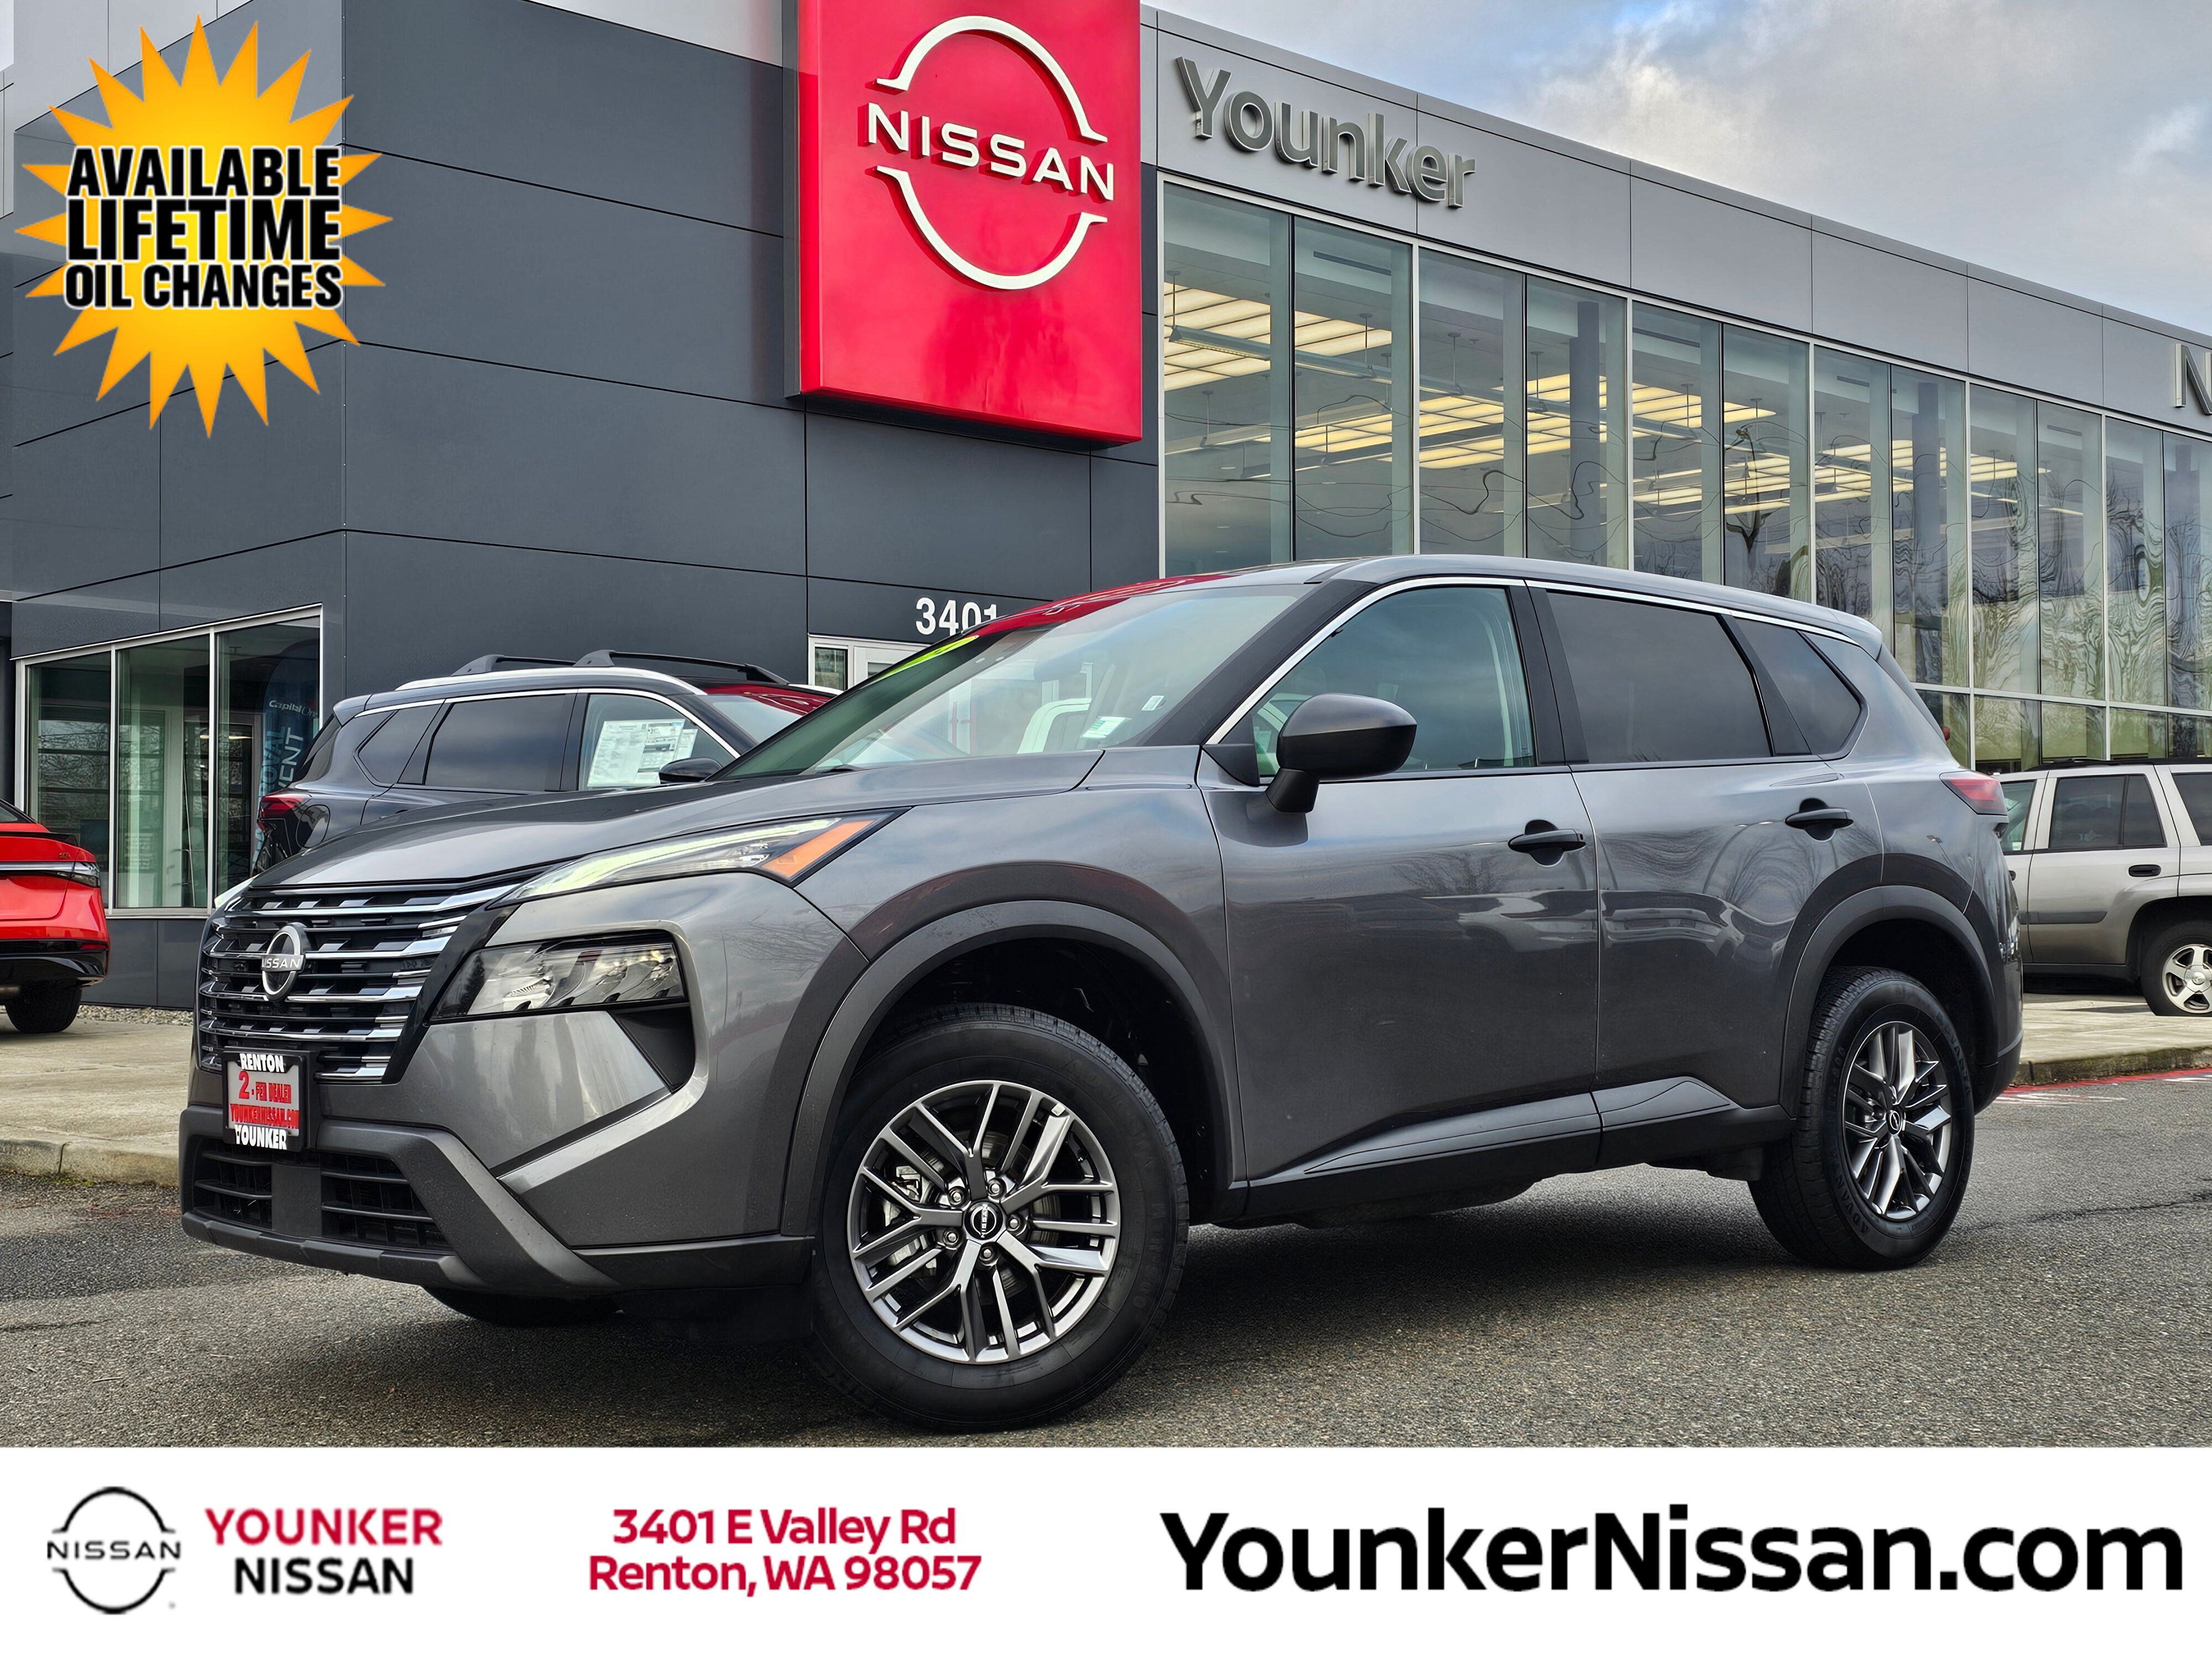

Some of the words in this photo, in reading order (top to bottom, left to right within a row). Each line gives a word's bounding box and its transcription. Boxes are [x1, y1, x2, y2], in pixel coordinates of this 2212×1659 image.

[868, 102, 1114, 201] NISSAN
[1176, 56, 1475, 209] Younker
[239, 1053, 284, 1073] RENTON
[234, 1124, 287, 1150] YOUNKER
